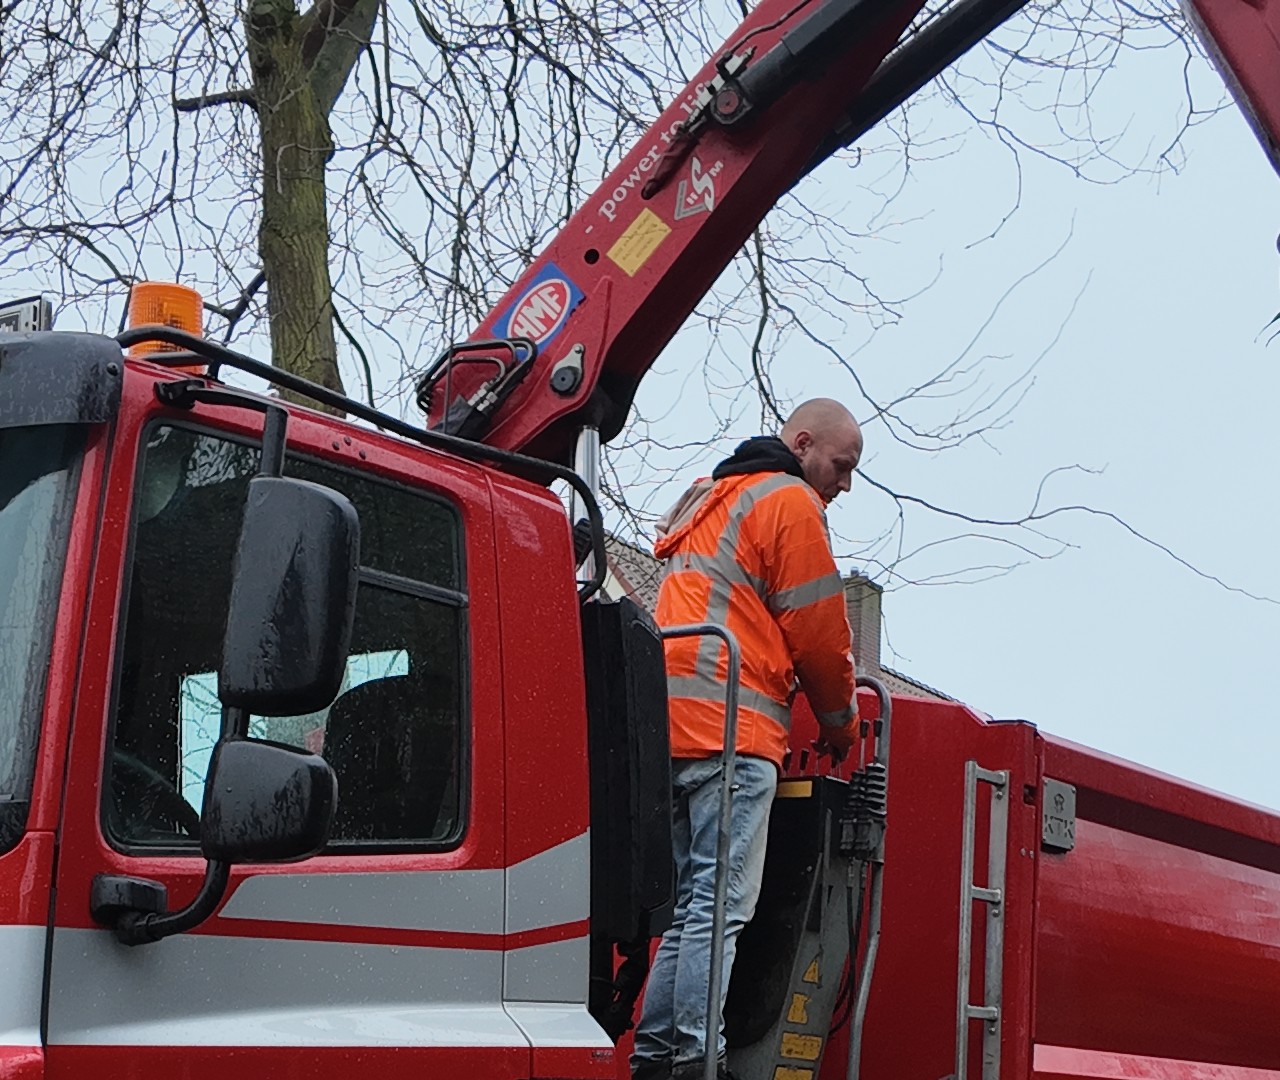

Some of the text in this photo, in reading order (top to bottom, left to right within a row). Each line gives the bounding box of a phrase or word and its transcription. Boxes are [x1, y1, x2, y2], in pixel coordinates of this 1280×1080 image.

[598, 145, 661, 222] power
[513, 285, 562, 339] HMF
[1044, 814, 1073, 839] KTK
